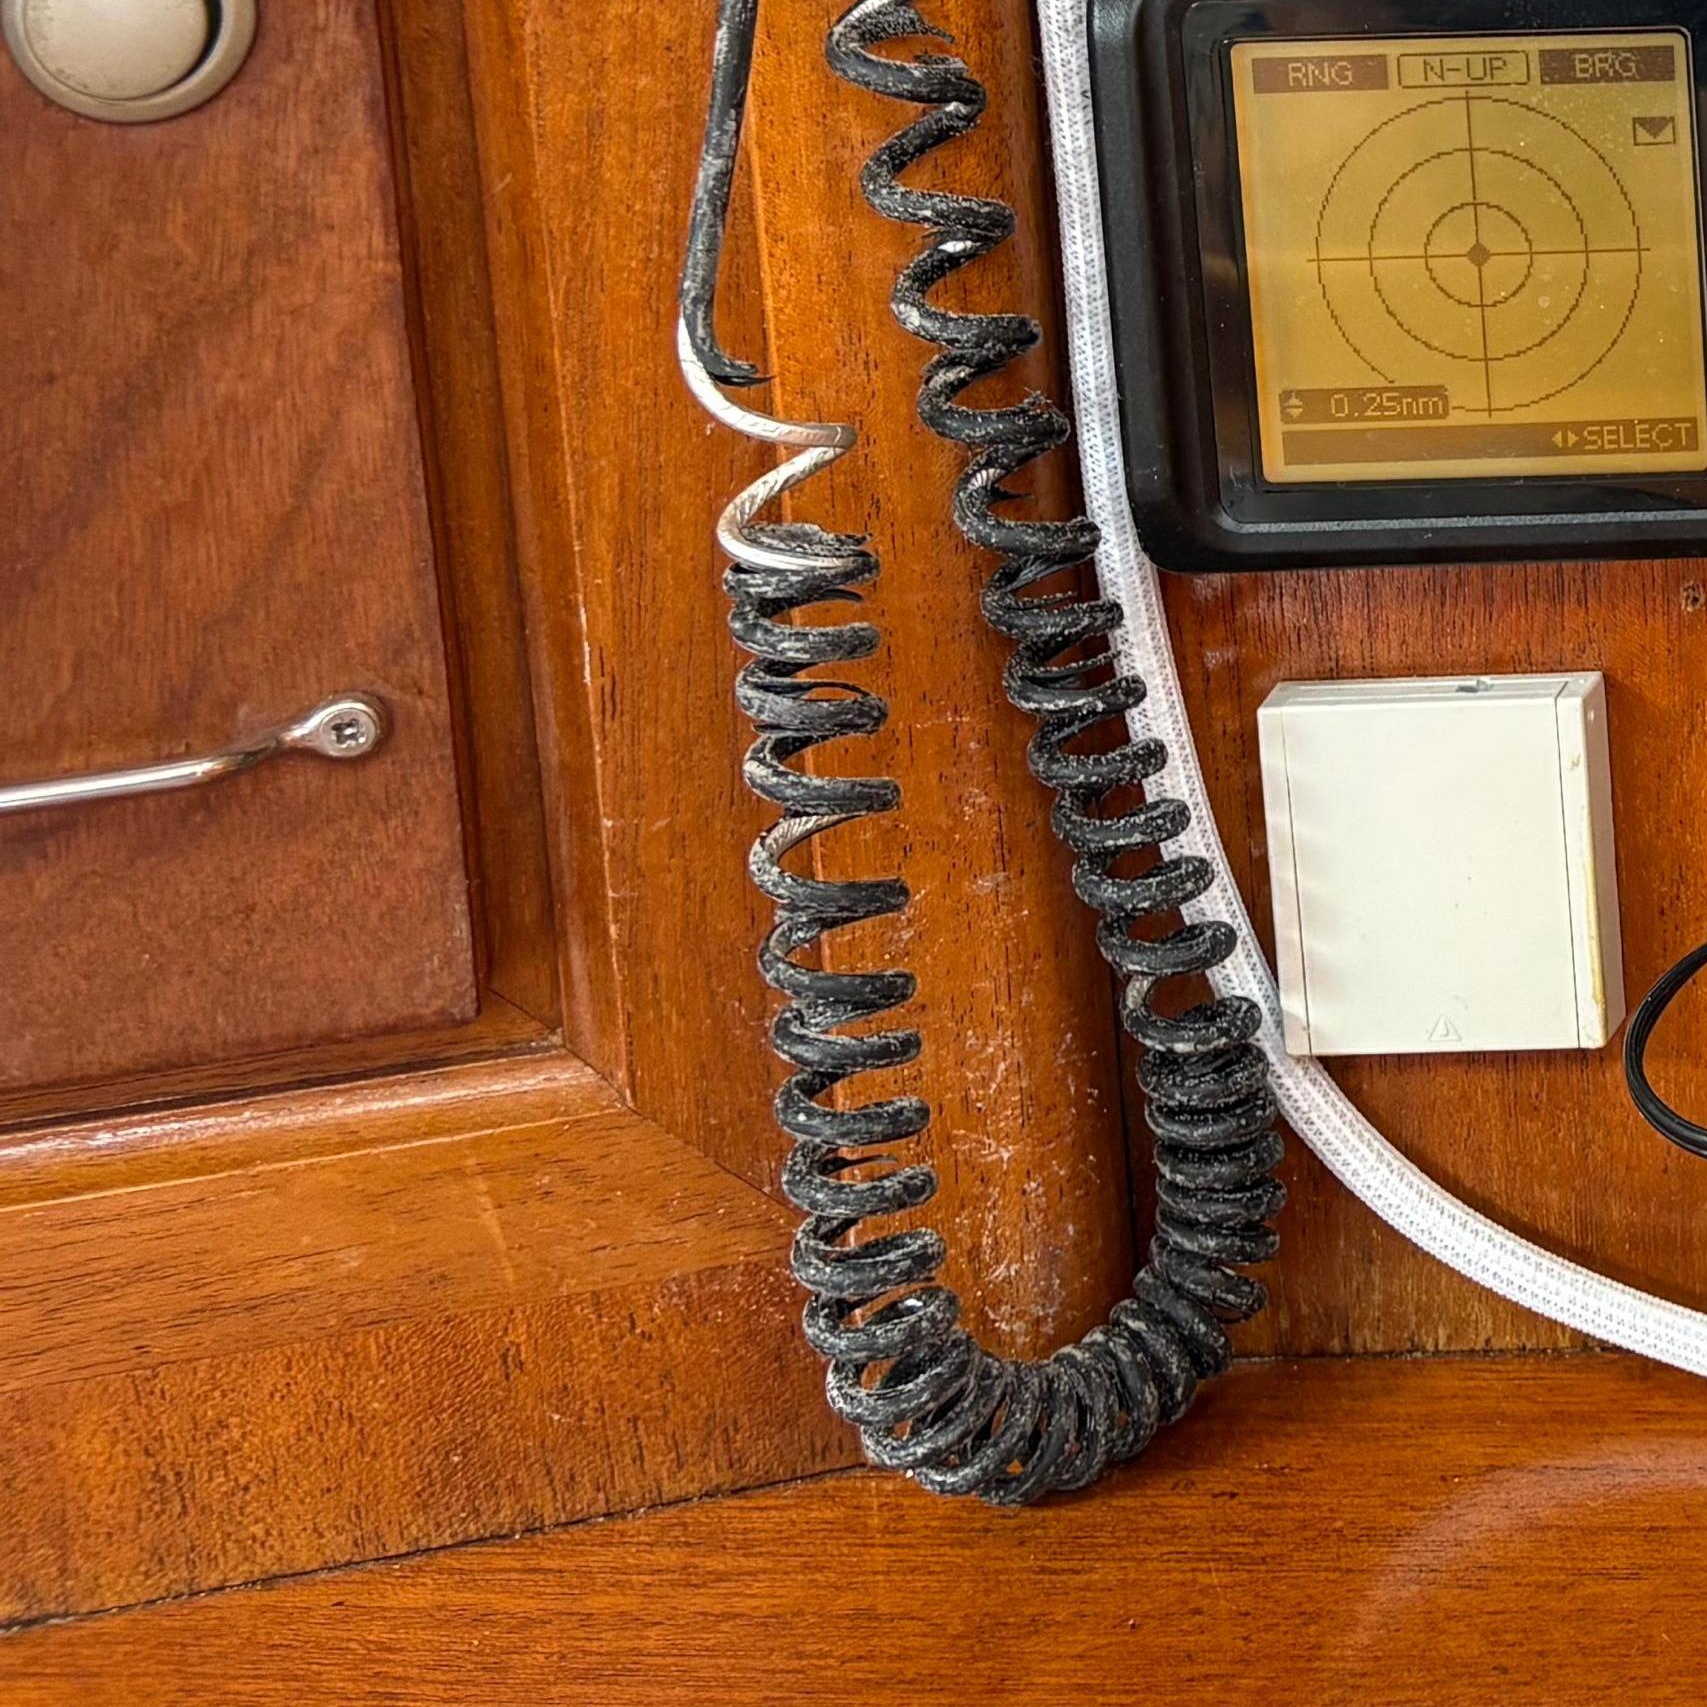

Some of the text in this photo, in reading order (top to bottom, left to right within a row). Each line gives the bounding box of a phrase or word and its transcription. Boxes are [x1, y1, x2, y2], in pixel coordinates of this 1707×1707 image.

[1288, 62, 1354, 87] RNG
[1424, 55, 1508, 81] N-UP
[1331, 393, 1444, 418] 0.25nm
[1584, 423, 1691, 450] SELECT
